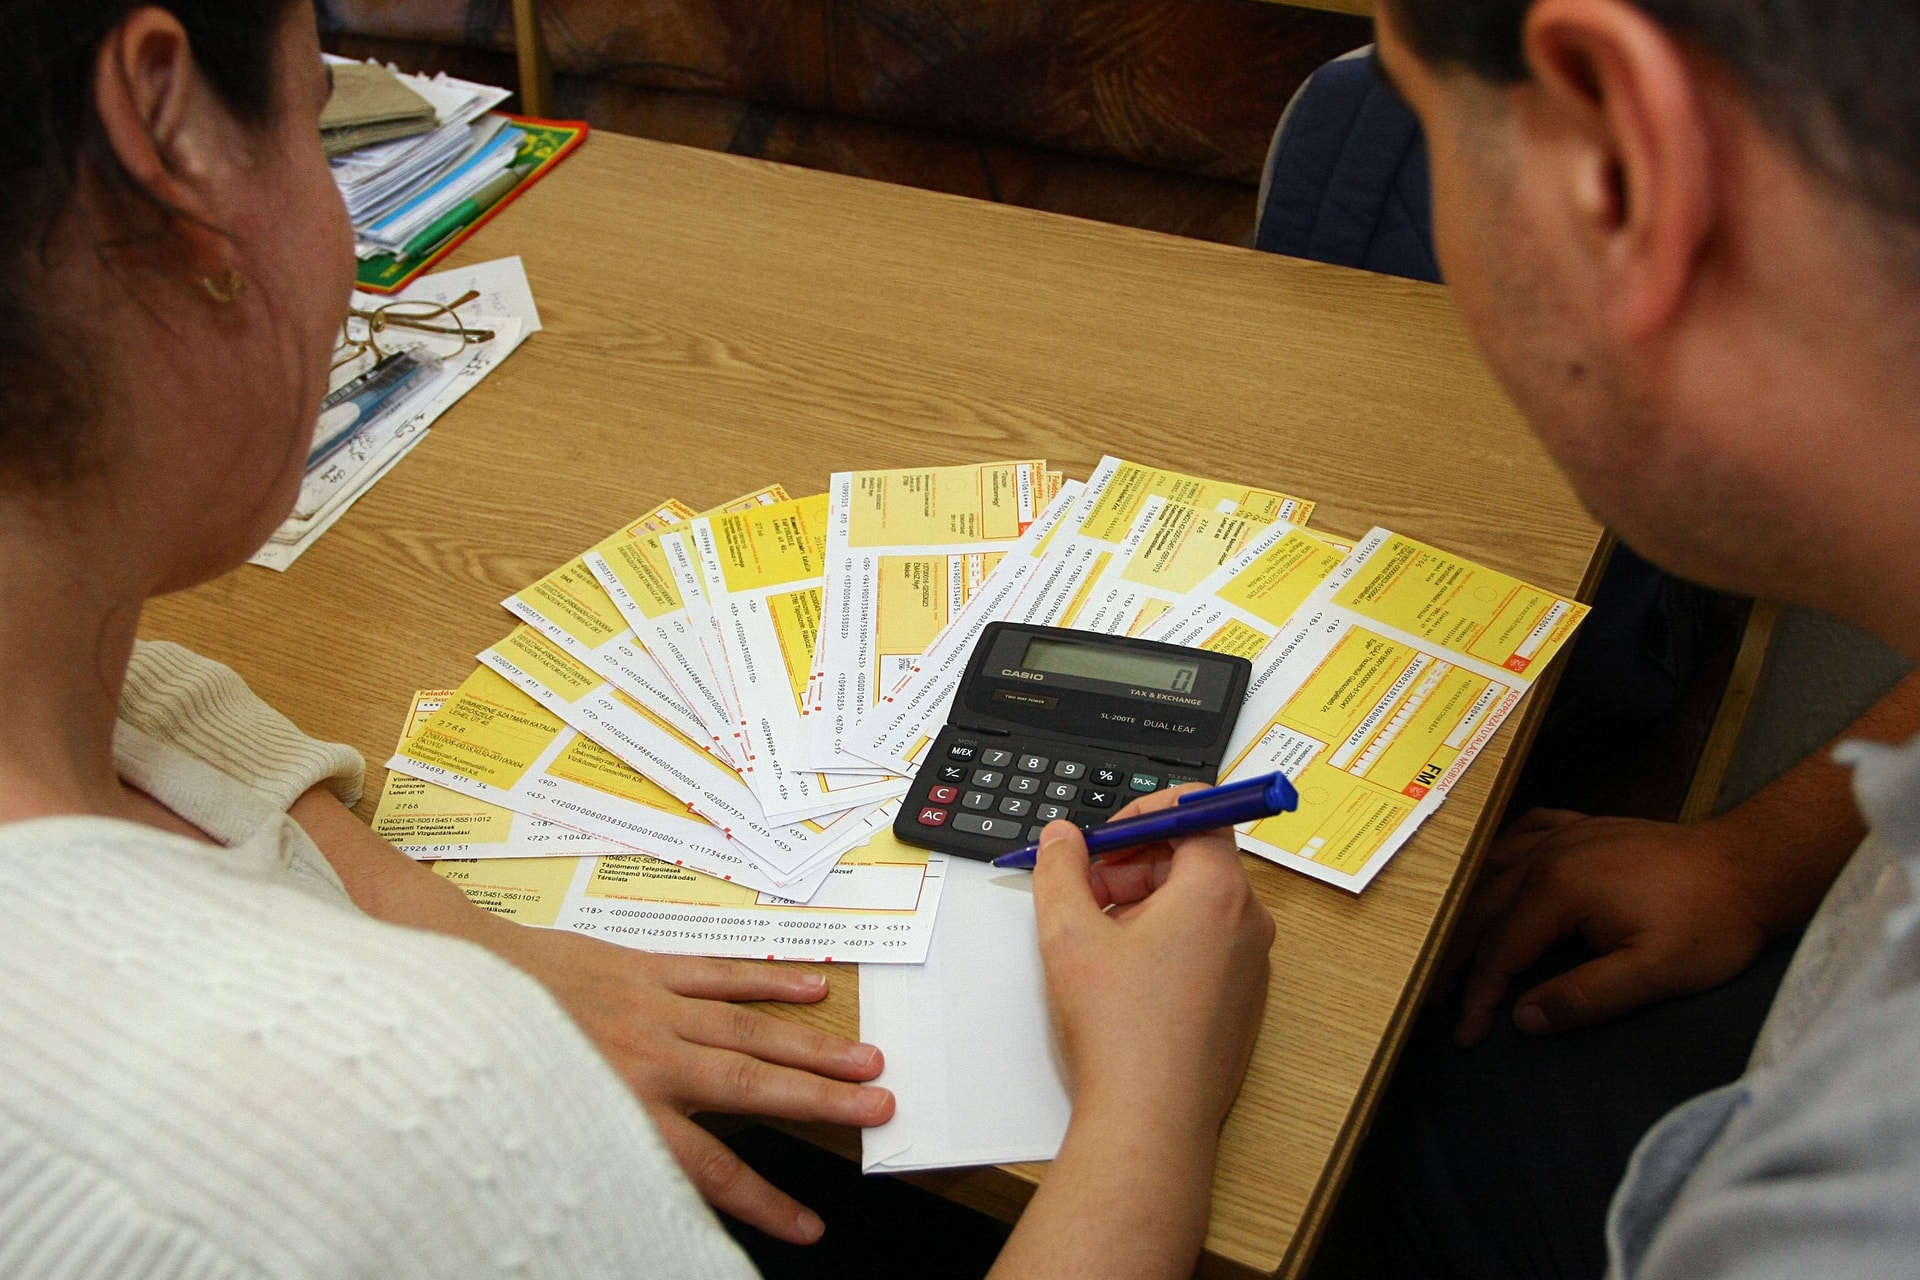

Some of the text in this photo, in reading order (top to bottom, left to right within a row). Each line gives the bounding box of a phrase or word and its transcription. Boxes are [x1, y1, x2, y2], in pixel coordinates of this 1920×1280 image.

[1084, 500, 1094, 511] 612
[1035, 495, 1076, 540] 02630407 611 51
[1138, 505, 1158, 534] 31868163
[839, 529, 847, 537] 51
[1196, 518, 1208, 534] 2766
[1131, 535, 1141, 546] 601
[700, 528, 720, 584] 00299969 677 55
[1065, 544, 1076, 558] <36>
[1082, 548, 1093, 562] <81>
[1229, 530, 1283, 577] 21199338 267 51
[1328, 537, 1380, 590] 03551497 627 54
[1014, 566, 1027, 579] <36>
[595, 559, 636, 611] 02003753 611 55
[685, 573, 699, 597] 670 51
[1106, 588, 1118, 603] <72>
[1124, 593, 1135, 607] <18>
[1191, 603, 1207, 616] <45>
[515, 602, 576, 645] 02003711 611 55
[1207, 611, 1222, 624] <90>
[1309, 611, 1323, 626] <18>
[656, 626, 668, 640] <72>
[673, 620, 685, 634] <72>
[1326, 618, 1340, 634] <18>
[1364, 638, 1377, 650] Eger
[618, 645, 634, 658] <72>
[603, 654, 619, 667] <27>
[492, 655, 553, 698] 02003737 611 55
[1001, 669, 1044, 681] CASIO
[837, 672, 846, 711] <10995525>
[856, 672, 865, 715] <000010614>
[908, 674, 939, 710] <02630407>
[1130, 688, 1203, 707] TAX & EXCHANGE
[598, 699, 614, 711] <72>
[835, 715, 843, 735] <670>
[889, 713, 906, 731] <611>
[891, 681, 956, 756] <000000647> <31> <51>
[1100, 712, 1136, 725] SL-200TE
[1464, 688, 1520, 757] KÉSZPÉNZÁTUTALÁSI
[530, 721, 558, 734] KATALIN
[1143, 719, 1197, 735] DUAL LEAF
[873, 734, 887, 749] <51>
[1260, 728, 1277, 746] 2766
[762, 717, 776, 756] <00299969>
[773, 760, 783, 779] <677>
[779, 784, 788, 800] <55>
[951, 746, 974, 757] M/EX
[992, 751, 1003, 762] 7
[1027, 758, 1039, 769] 8
[1064, 764, 1075, 775] 9
[407, 758, 445, 775] 11734693
[453, 774, 468, 783] 611
[476, 782, 487, 790] 54
[583, 708, 599, 721] <72>
[703, 790, 746, 821] <02003737>
[749, 821, 771, 839] <611>
[774, 839, 792, 852] <55>
[981, 773, 993, 783] 4
[1100, 770, 1113, 781] %
[1415, 762, 1442, 788] FM
[1436, 756, 1469, 792] MEGBÍZÁS
[538, 778, 558, 788] <90>
[800, 780, 808, 796] <55>
[1019, 779, 1031, 790] 5
[936, 788, 950, 799] C
[1056, 785, 1067, 796] 6
[975, 794, 982, 805] 1
[1009, 800, 1021, 812] 2
[922, 810, 943, 821] AC
[1046, 807, 1058, 818] 3
[526, 790, 546, 800] <45>
[689, 843, 743, 864] <11734693>
[981, 820, 993, 831] 0
[789, 828, 808, 841] <55>
[602, 862, 681, 874] Tápiómenti Települések
[597, 875, 628, 883] Társulata
[579, 906, 603, 914] <18>
[778, 921, 847, 930] <000002160>
[573, 922, 597, 931] <72>
[604, 925, 766, 942] <104021425051545155511012>
[773, 937, 836, 946] <31868192>
